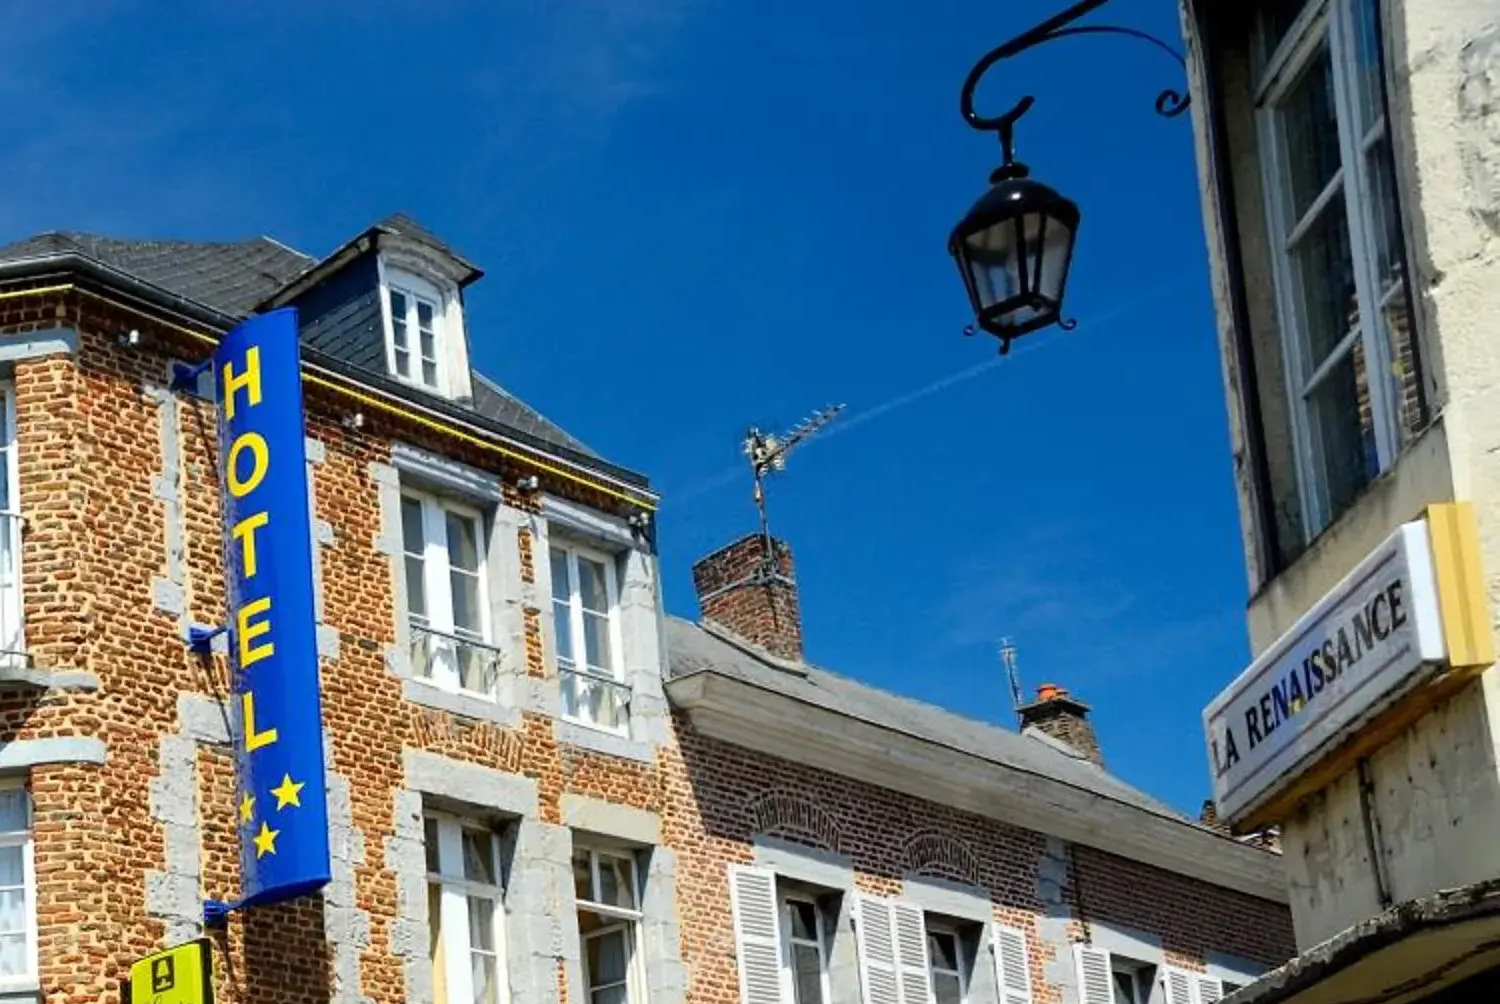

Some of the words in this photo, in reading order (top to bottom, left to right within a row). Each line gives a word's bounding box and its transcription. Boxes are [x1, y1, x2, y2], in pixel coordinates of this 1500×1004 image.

[223, 345, 278, 753] HOTEL
[1210, 724, 1241, 780] LA
[1244, 578, 1408, 751] RENAISSANCE
